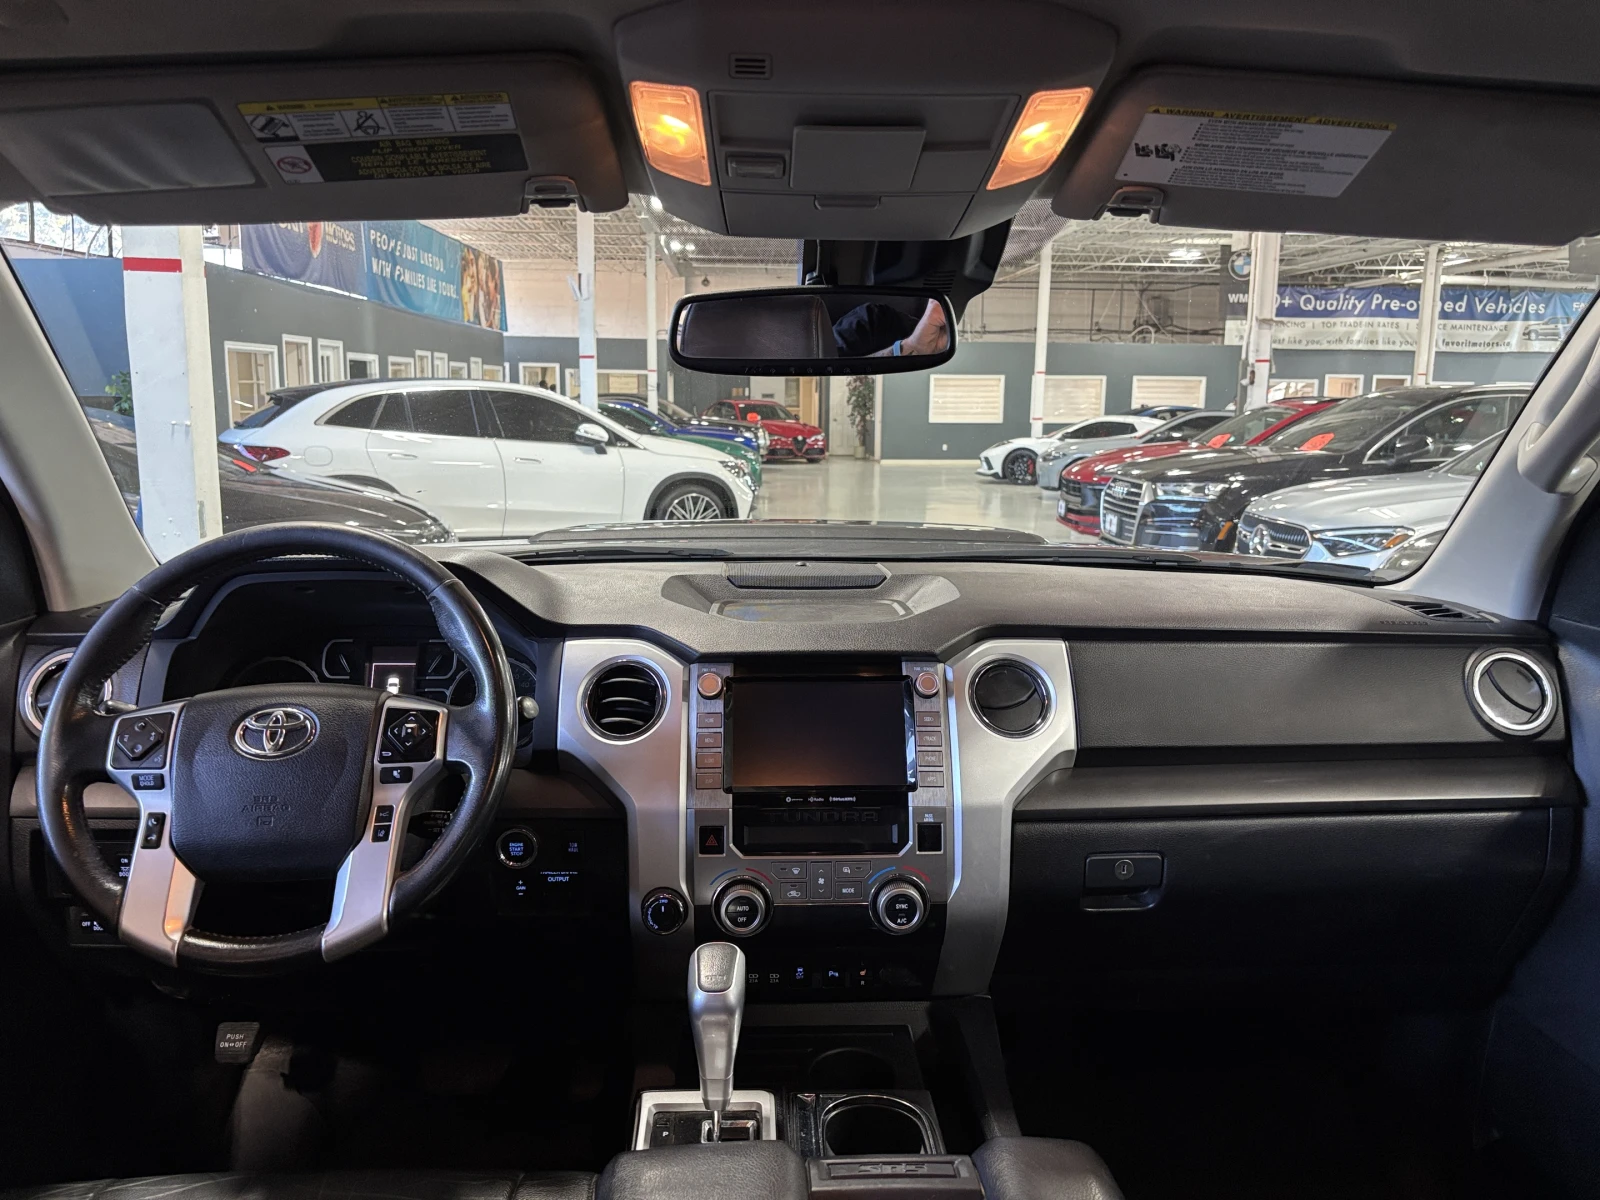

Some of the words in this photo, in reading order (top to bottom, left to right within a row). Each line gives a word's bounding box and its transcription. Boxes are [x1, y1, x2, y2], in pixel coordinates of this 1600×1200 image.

[1165, 108, 1214, 118] WARNING
[1223, 112, 1309, 124] AVERTISSEMENT
[1316, 118, 1390, 131] ADVERTENCIA
[380, 140, 391, 148] AIR
[395, 140, 412, 148] BAG
[415, 138, 450, 146] WARNING
[351, 156, 384, 164] COUSSIN
[325, 223, 356, 252] MOTORS
[402, 243, 418, 262] JUST
[372, 256, 392, 280] WITH
[394, 266, 426, 290] FAMILIES
[1300, 294, 1366, 315] Quality
[1371, 294, 1467, 313] Pre-oed
[1474, 296, 1546, 314] Vehicles
[1321, 321, 1338, 329] TOP
[1377, 322, 1400, 330] RATES
[1450, 324, 1508, 332] MAINTENANCE
[1288, 336, 1304, 344] like
[1326, 336, 1344, 345] with
[764, 810, 880, 822] TUNDRA
